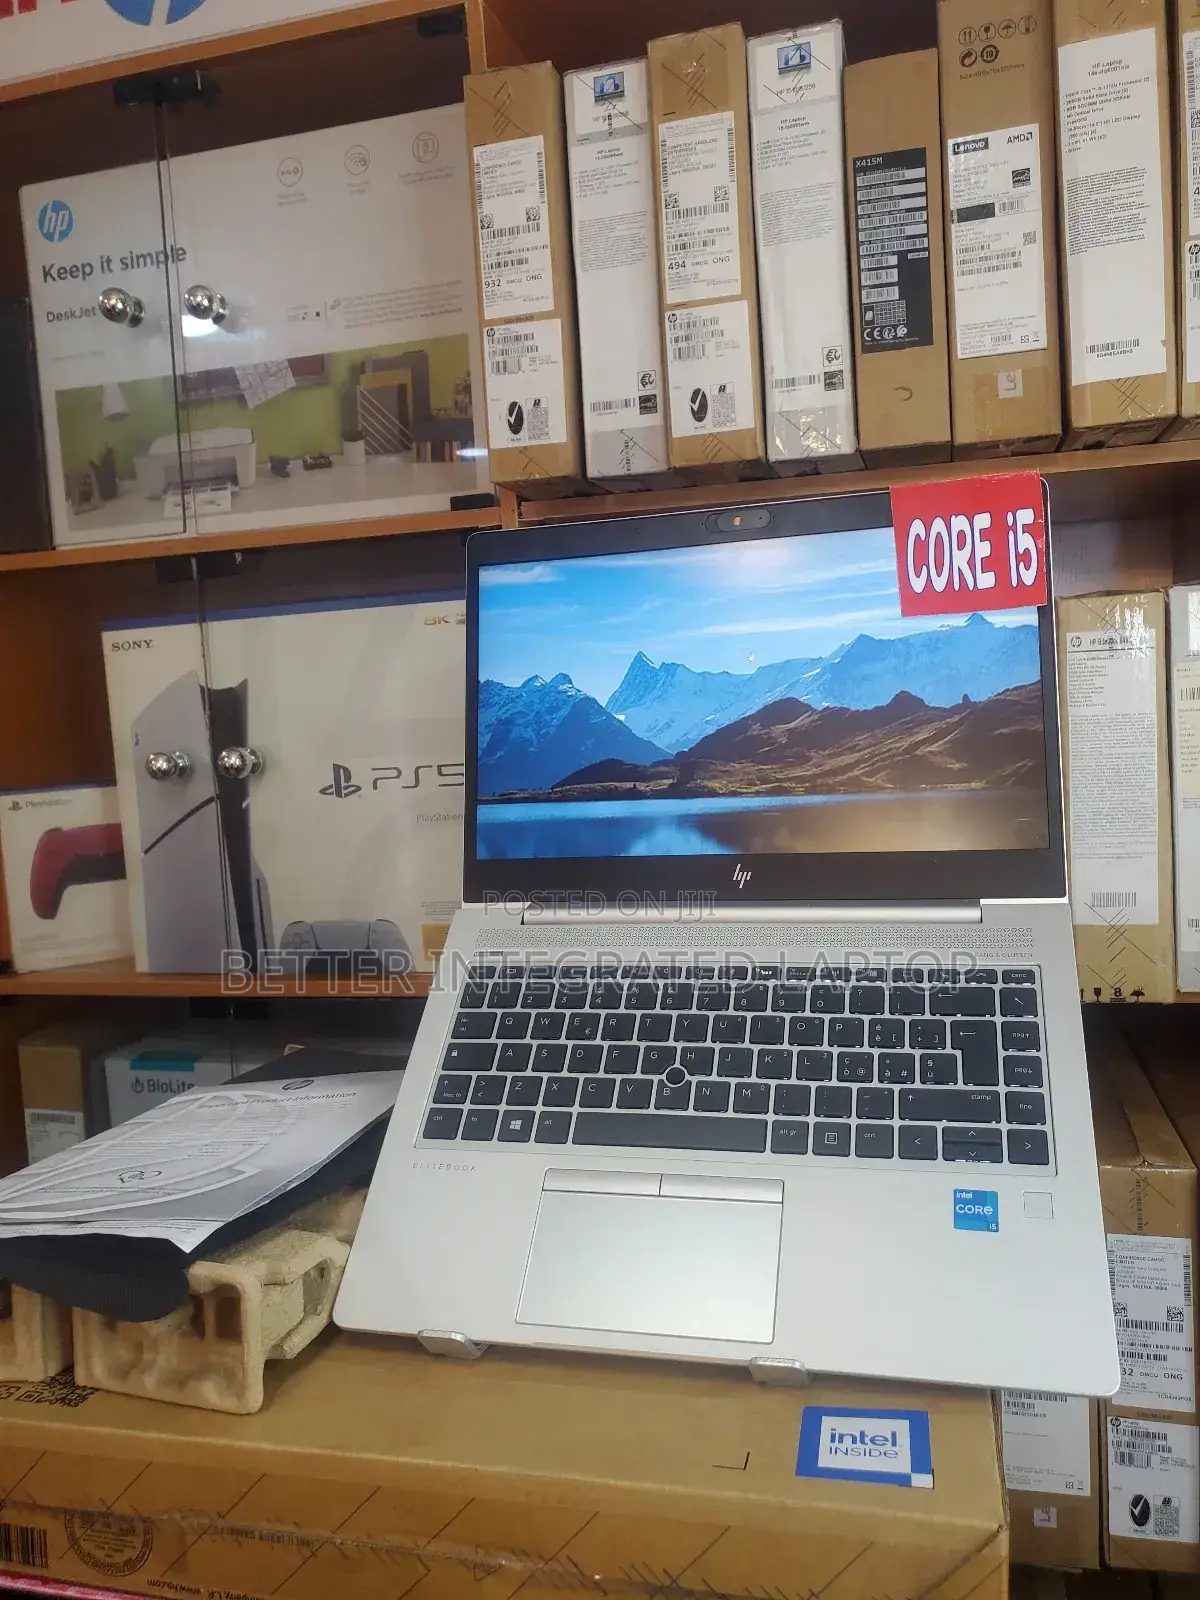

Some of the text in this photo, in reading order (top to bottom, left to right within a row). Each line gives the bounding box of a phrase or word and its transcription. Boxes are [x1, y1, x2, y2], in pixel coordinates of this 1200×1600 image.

[1102, 59, 1123, 68] Laptop
[1123, 114, 1140, 122] Display
[667, 138, 718, 151] COMPETENT HANDLERS
[1006, 134, 1026, 144] AMD
[954, 142, 986, 152] Lenovo
[856, 157, 883, 167] X415M
[40, 200, 72, 242] hp
[42, 244, 187, 283] Keep it simple
[668, 260, 686, 270] 494
[484, 279, 501, 288] 932
[526, 274, 542, 282] ONG
[47, 306, 97, 323] DeskJet
[907, 508, 1039, 594] CORE i5
[424, 614, 450, 626] 8K
[111, 640, 152, 651] SONY
[371, 763, 464, 791] PS5
[26, 798, 72, 809] PlayStation
[416, 813, 464, 823] PlayStation
[733, 863, 752, 889] hp
[542, 1049, 547, 1057] S
[147, 1079, 195, 1094] BioLite
[703, 1087, 710, 1095] N
[743, 1089, 751, 1097] M
[250, 1096, 291, 1106] Product
[292, 1092, 356, 1103] Information
[412, 1162, 478, 1172] ELITEBOOK
[954, 1190, 973, 1200] intel
[988, 1222, 997, 1231] i5
[1111, 1417, 1121, 1427] hp
[829, 1428, 897, 1447] intel
[147, 1578, 201, 1595] www.hp.com
